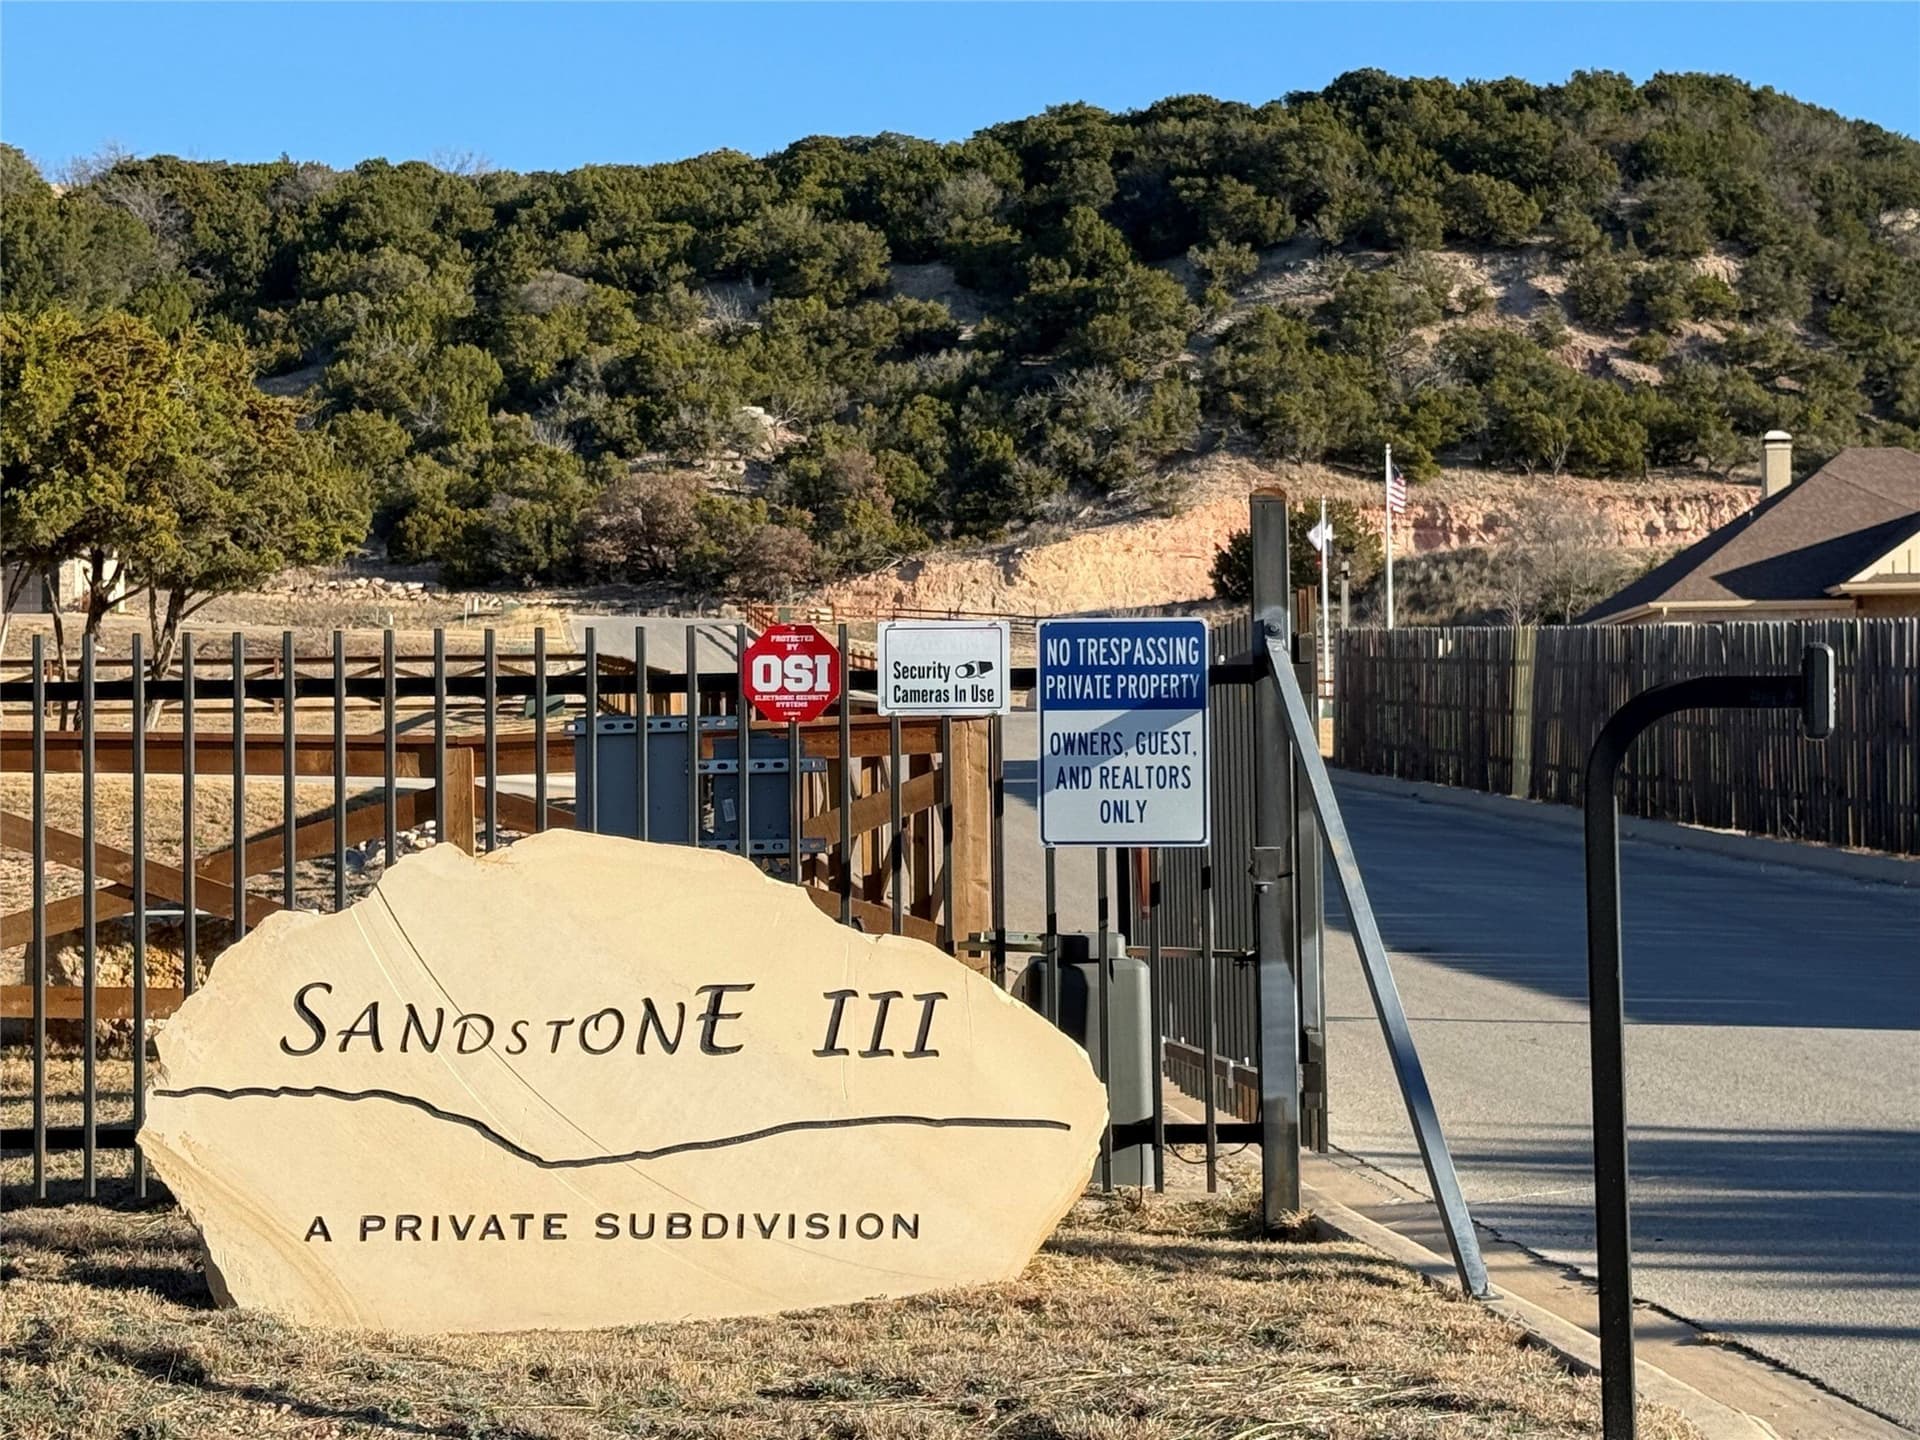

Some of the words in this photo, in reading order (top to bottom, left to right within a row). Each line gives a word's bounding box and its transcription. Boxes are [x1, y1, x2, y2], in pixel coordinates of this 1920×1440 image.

[786, 643, 799, 651] BY
[1047, 638, 1070, 666] NO
[1077, 637, 1199, 665] TRESPASSING
[752, 655, 831, 692] OSI
[893, 661, 950, 683] Security
[893, 684, 950, 703] Cameras
[954, 684, 967, 703] In
[971, 684, 995, 703] Use
[1046, 675, 1111, 699] PRIVATE
[1117, 673, 1199, 698] PROPERTY
[1050, 732, 1129, 757] OWNERS,
[1135, 731, 1197, 756] GUEST,
[1055, 765, 1092, 789] AND
[1100, 765, 1191, 790] REALTORS
[1100, 799, 1148, 824] ONLY
[279, 982, 756, 1056] SANDSTONE
[812, 989, 949, 1059] III
[304, 1216, 333, 1242] A
[360, 1214, 568, 1242] PRIVATE
[596, 1213, 919, 1240] SUBDIVISION
